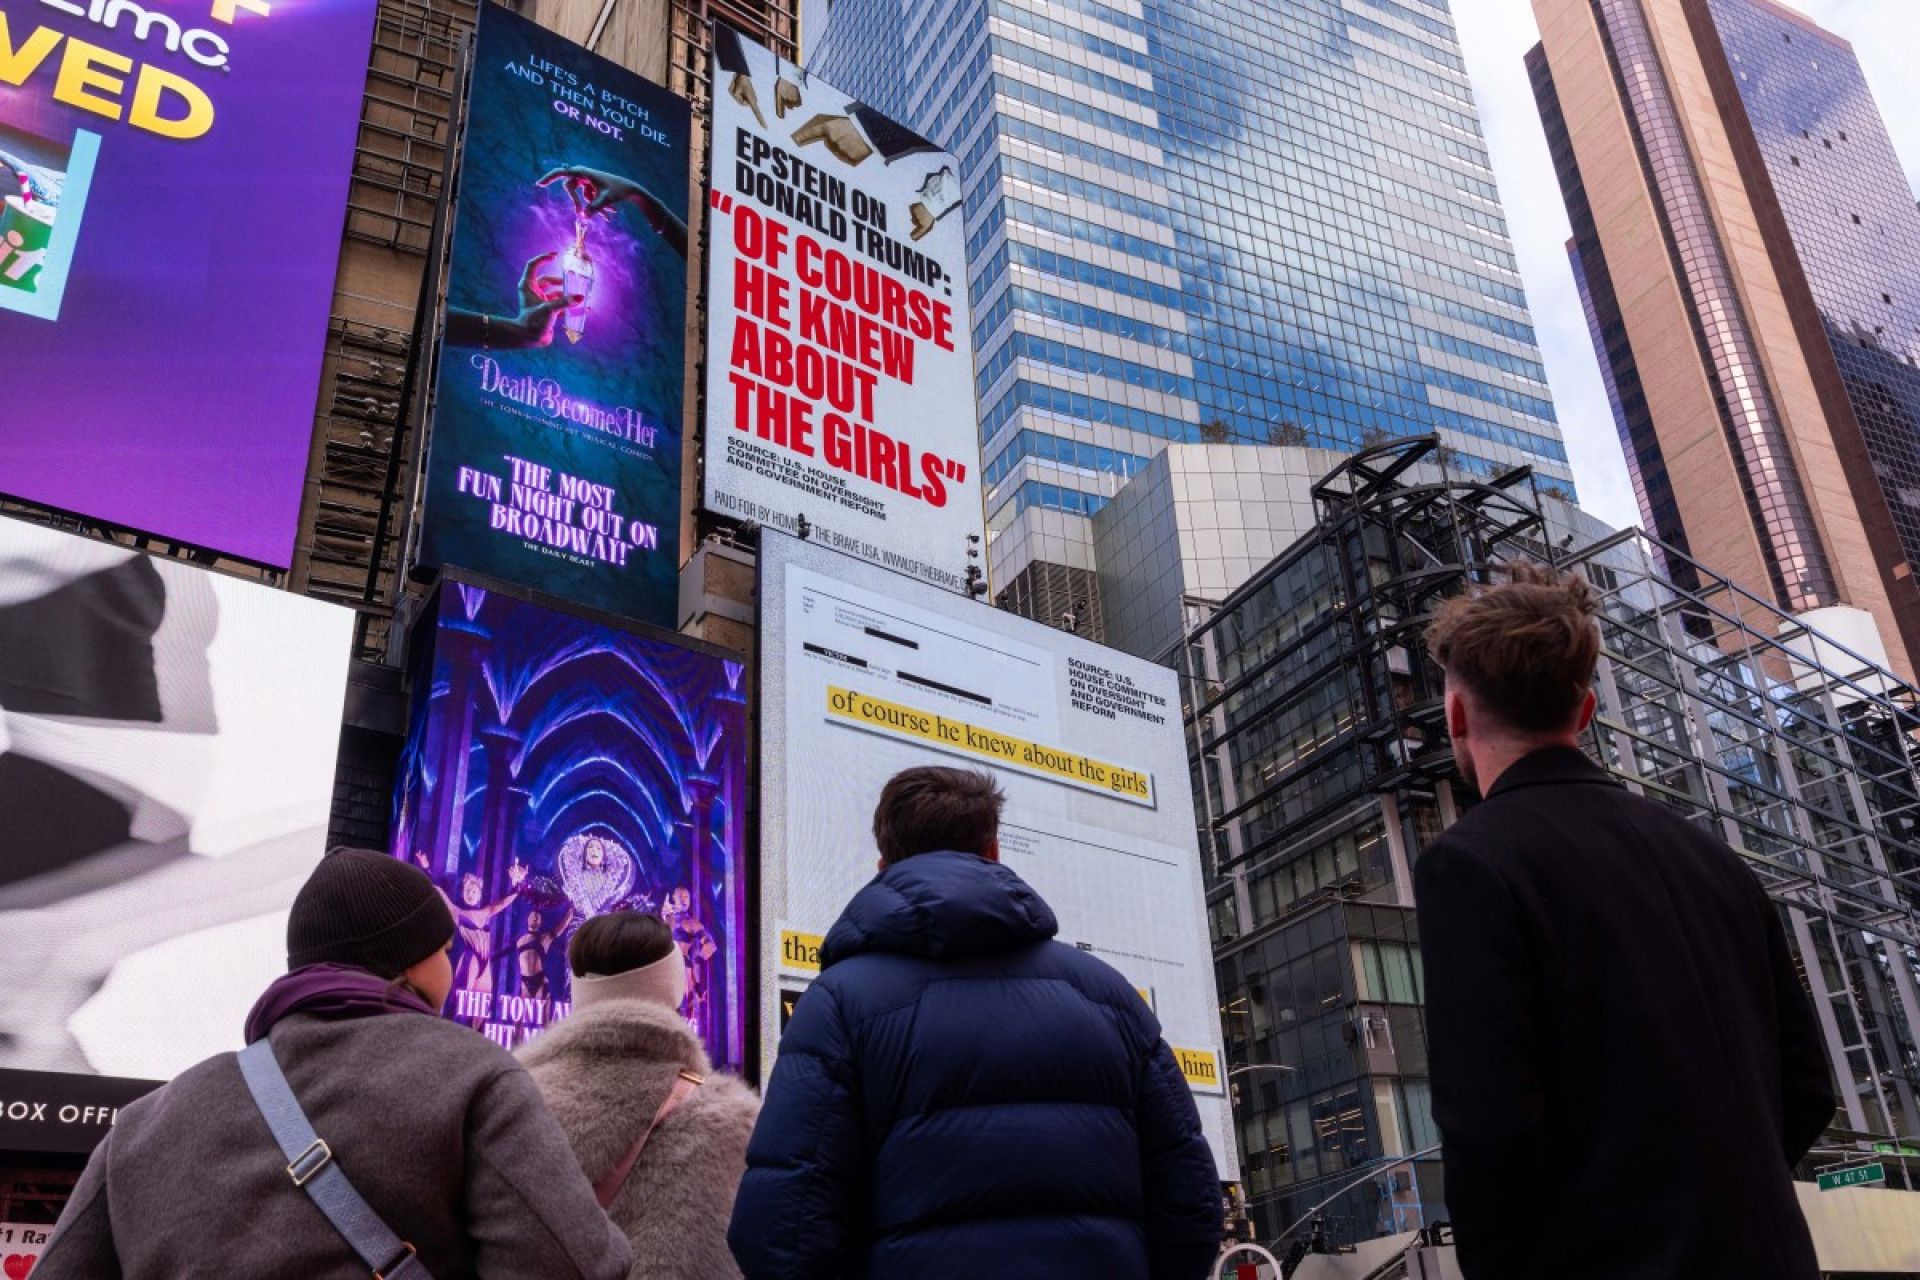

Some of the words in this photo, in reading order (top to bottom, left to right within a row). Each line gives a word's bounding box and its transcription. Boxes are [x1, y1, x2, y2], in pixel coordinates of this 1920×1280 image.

[530, 54, 577, 86] LIFE'S
[584, 82, 595, 95] A
[504, 61, 544, 86] AND
[550, 80, 594, 110] THEN
[599, 104, 635, 129] YOU
[641, 124, 671, 147] DIE.
[553, 100, 580, 121] OR
[585, 116, 623, 141] NOT.
[737, 126, 846, 211] EPSTEIN
[852, 188, 887, 232] ON
[735, 159, 847, 243] DONALD
[852, 220, 952, 297] TRUMP:
[711, 189, 788, 270] "OF
[795, 234, 955, 352] COURSE
[734, 257, 791, 331] HE
[799, 287, 915, 385] KNEW
[731, 315, 878, 423] ABOUT
[470, 353, 537, 406] Death
[537, 379, 622, 437] Becomes
[616, 406, 658, 449] Her
[727, 436, 781, 462] SOURCE:
[783, 457, 806, 473] U.S.
[807, 466, 847, 488] HOUSE
[729, 370, 815, 458] THE
[823, 412, 967, 508] GIRLS"
[559, 473, 615, 511] MOST
[726, 455, 753, 471] AND
[756, 466, 837, 502] GOVERNMENT
[840, 497, 887, 520] REFORM
[727, 445, 799, 479] COMMITTEE
[802, 473, 819, 486] ON
[821, 481, 885, 510] OVERSIGHT
[458, 466, 502, 501] FUN
[511, 484, 574, 524] NIGHT
[582, 506, 623, 539] OUT
[630, 521, 657, 550] ON
[714, 489, 737, 510] PAID
[738, 498, 756, 518] FOR
[758, 505, 770, 523] BY
[814, 524, 831, 543] THE
[833, 531, 860, 554] BRAVE
[524, 541, 539, 551] THE
[542, 547, 567, 559] DAILY
[569, 555, 595, 567] BEAST
[1068, 657, 1112, 679] SOURCE:
[1115, 673, 1135, 687] U.S.
[1068, 667, 1105, 687] HOUSE
[1106, 680, 1166, 707] COMMITTEE
[1069, 678, 1086, 690] ON
[1087, 684, 1146, 709] OVERSIGHT
[1070, 689, 1093, 702] AND
[1095, 696, 1165, 725] GOVERNMENT
[1071, 698, 1116, 720] REFORM
[832, 690, 859, 713] of
[862, 702, 930, 734] course
[936, 715, 960, 742] he
[965, 724, 1017, 758] knew
[1024, 743, 1074, 774] about
[1078, 757, 1105, 782] the
[1110, 767, 1147, 795] girls
[456, 989, 492, 1018] THE
[500, 994, 546, 1025] TONY
[484, 1023, 515, 1051] HIT
[1182, 1053, 1216, 1078] him
[1832, 1175, 1840, 1185] W
